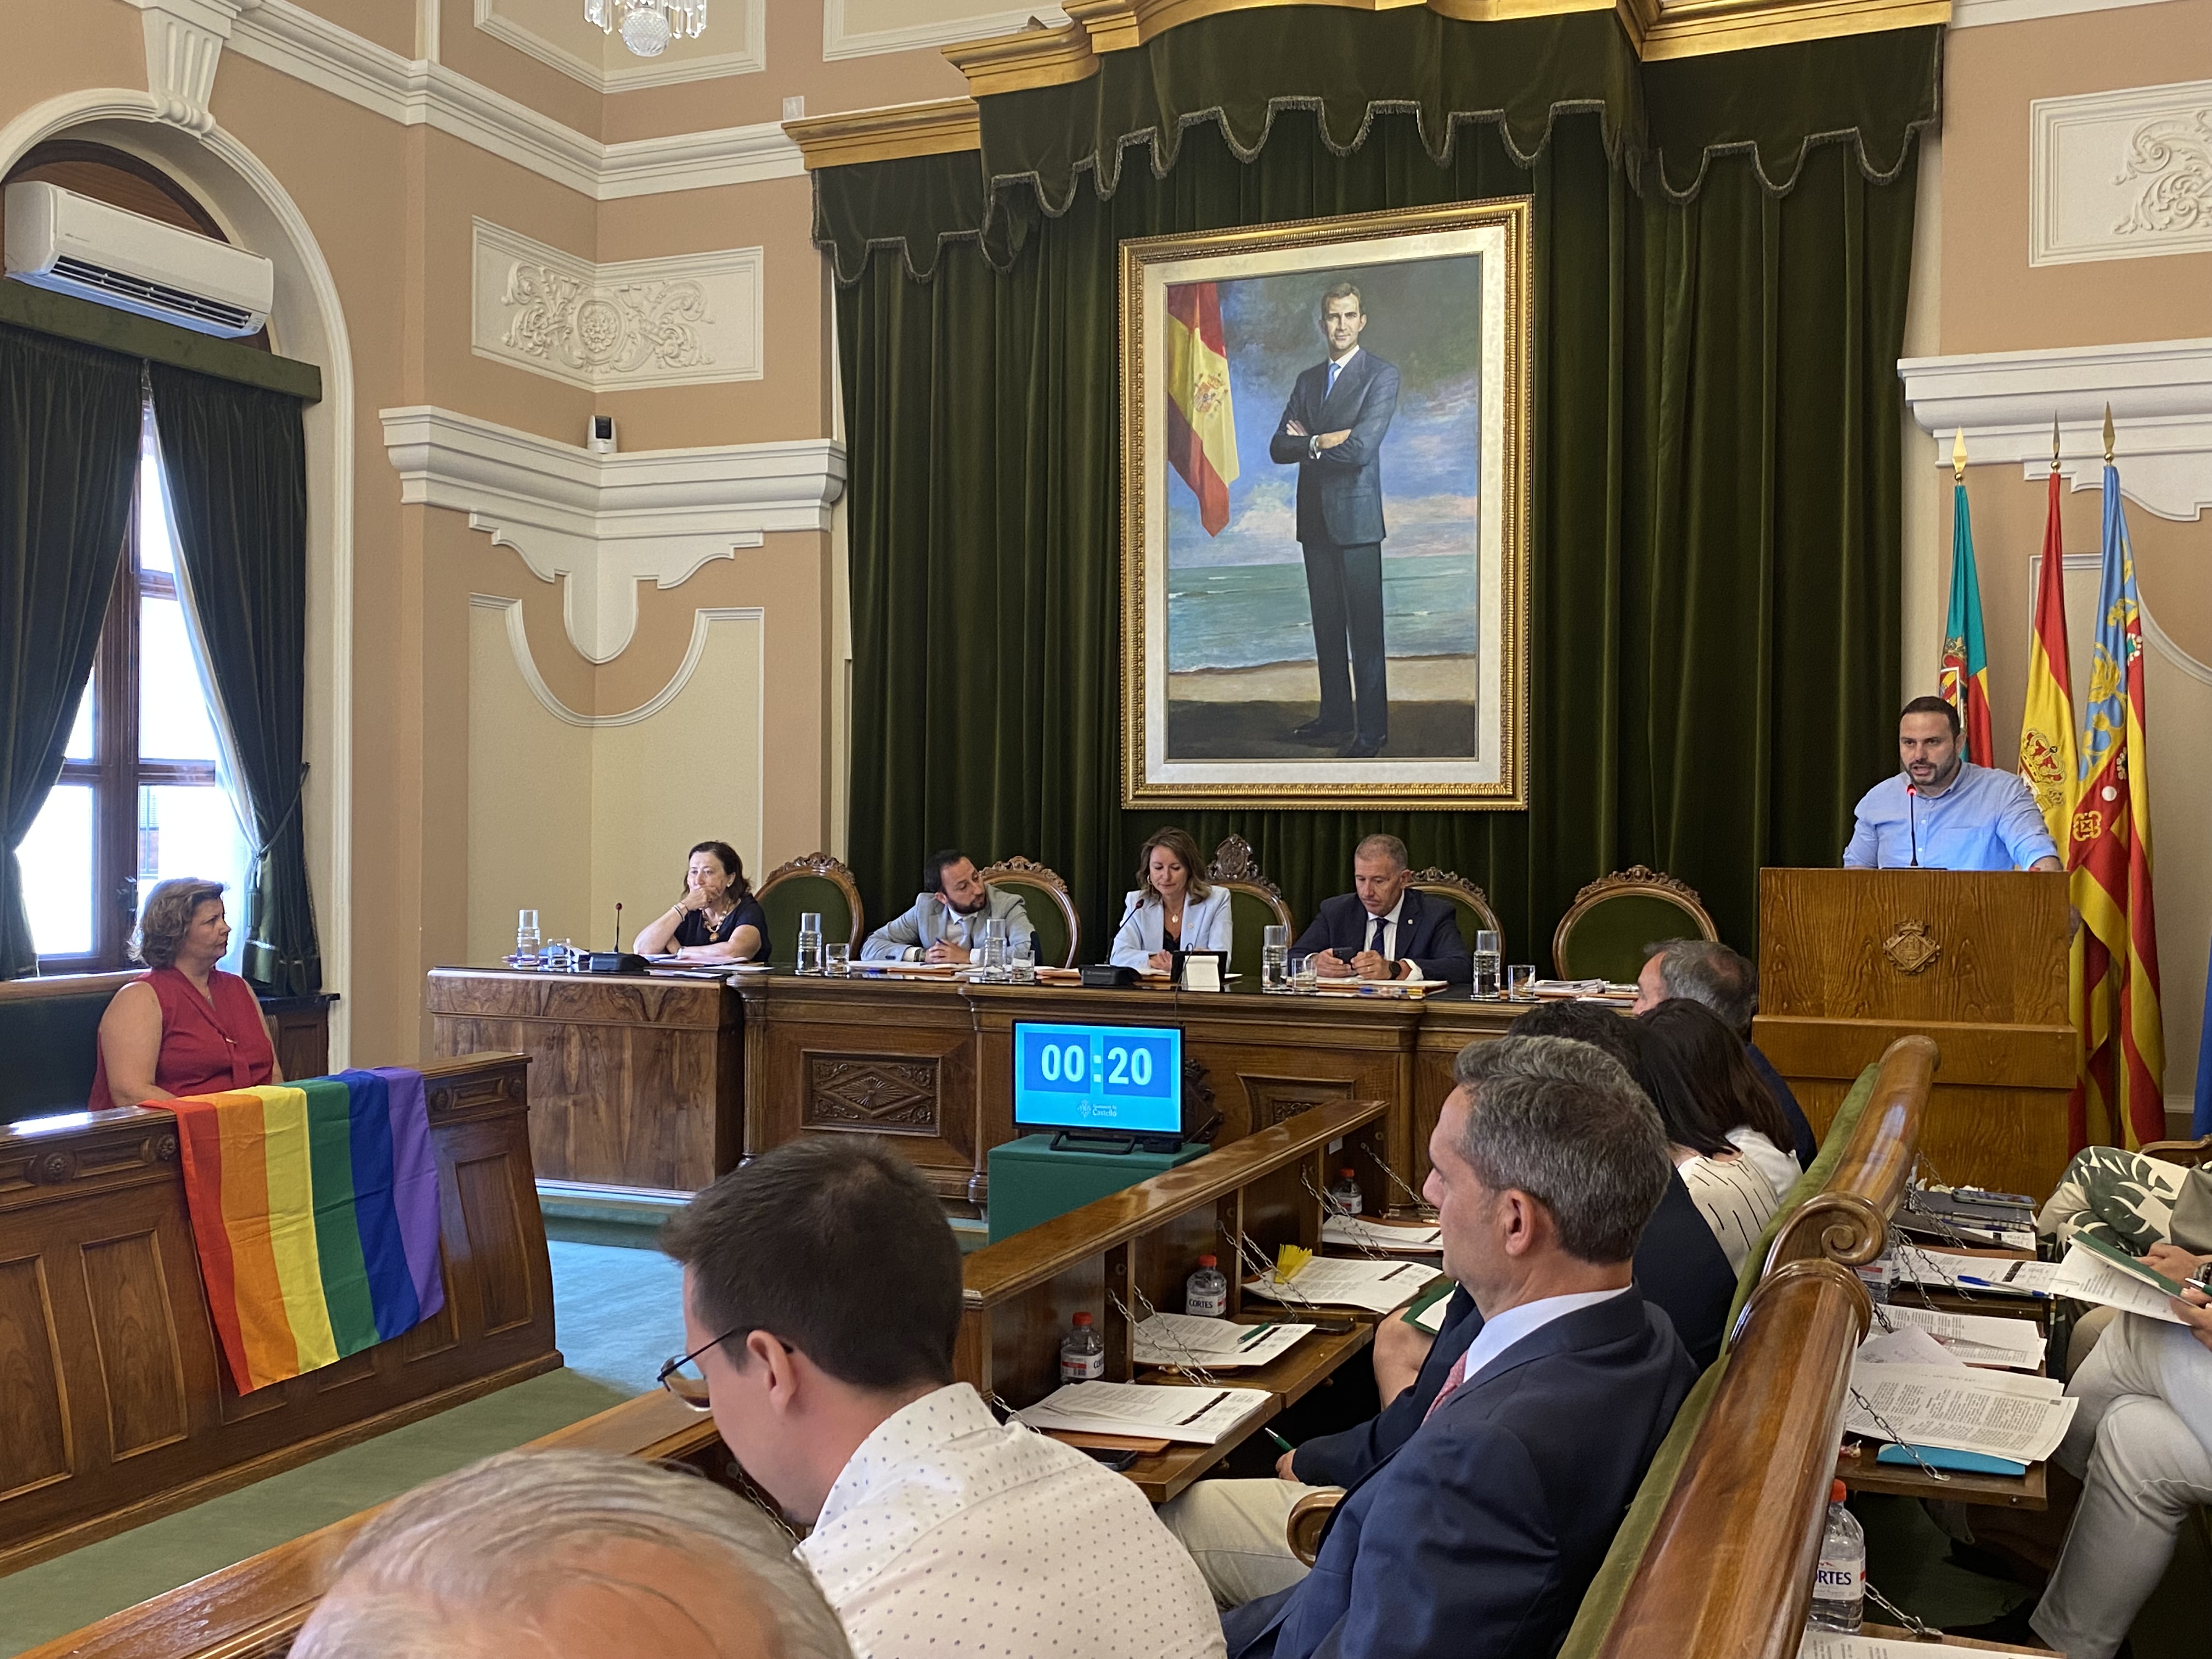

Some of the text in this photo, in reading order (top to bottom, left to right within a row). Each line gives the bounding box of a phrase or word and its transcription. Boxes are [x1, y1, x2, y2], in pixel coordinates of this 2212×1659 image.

[1042, 1043, 1152, 1086] 00:20
[1189, 1299, 1213, 1308] CORTES
[1818, 1570, 1852, 1585] RTES
